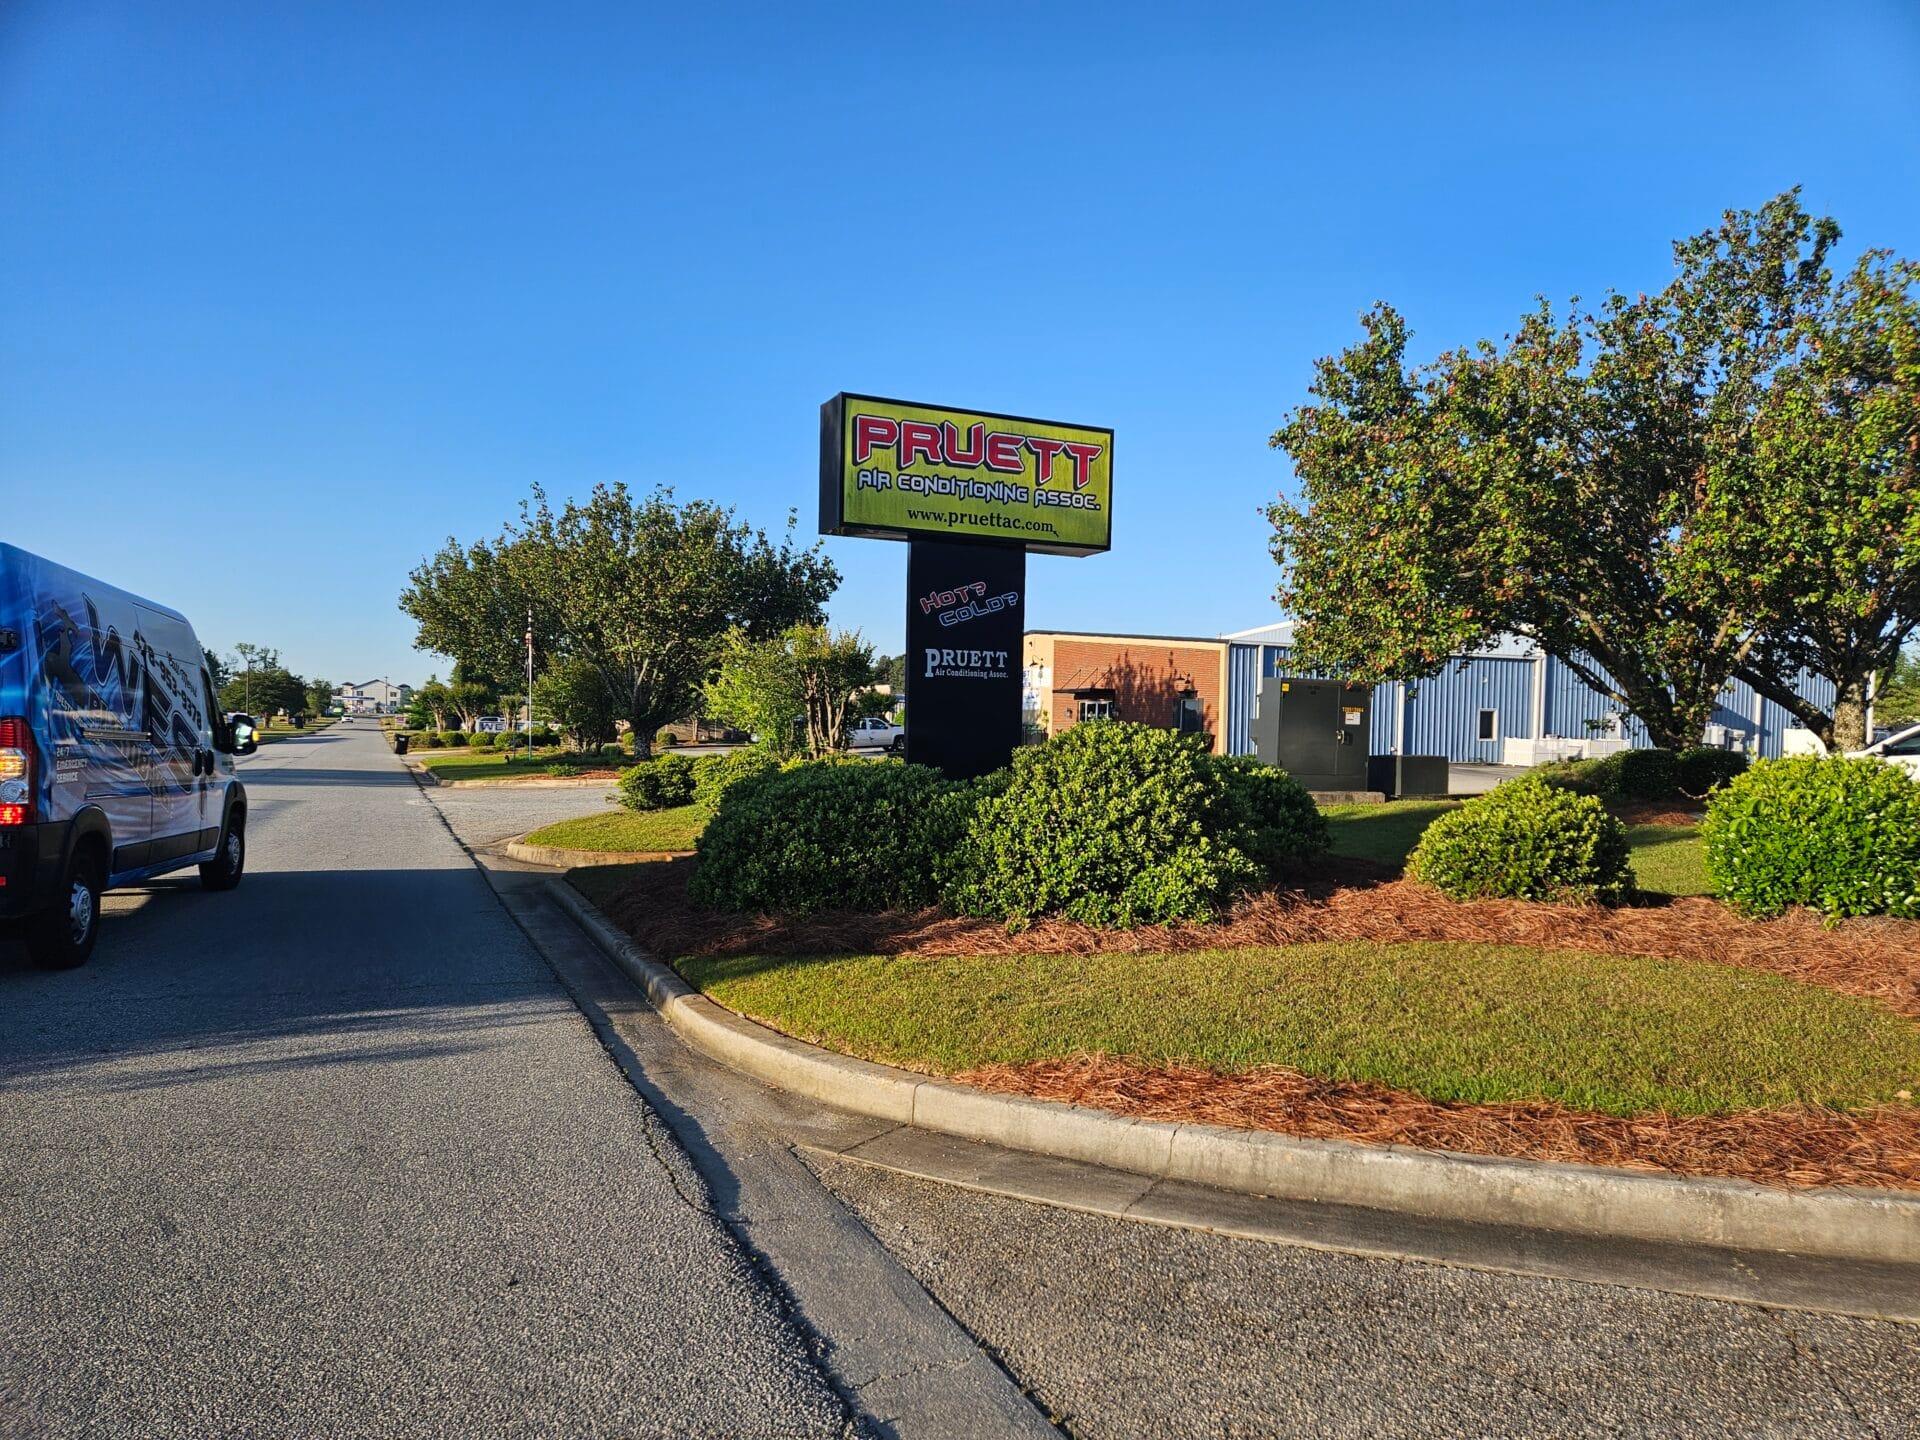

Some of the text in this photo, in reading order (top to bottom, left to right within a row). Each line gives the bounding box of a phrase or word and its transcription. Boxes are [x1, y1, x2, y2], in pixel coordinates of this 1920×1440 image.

[853, 415, 1103, 489] PRUETT
[858, 468, 1101, 509] AIR CONDITIONING ASSOC.
[907, 508, 1054, 533] www.pruettac.com
[920, 581, 987, 614] HOT?
[939, 591, 1019, 626] COLD?
[925, 648, 1008, 678] PRUETT
[935, 667, 1009, 679] Air Conditioning Assoc.
